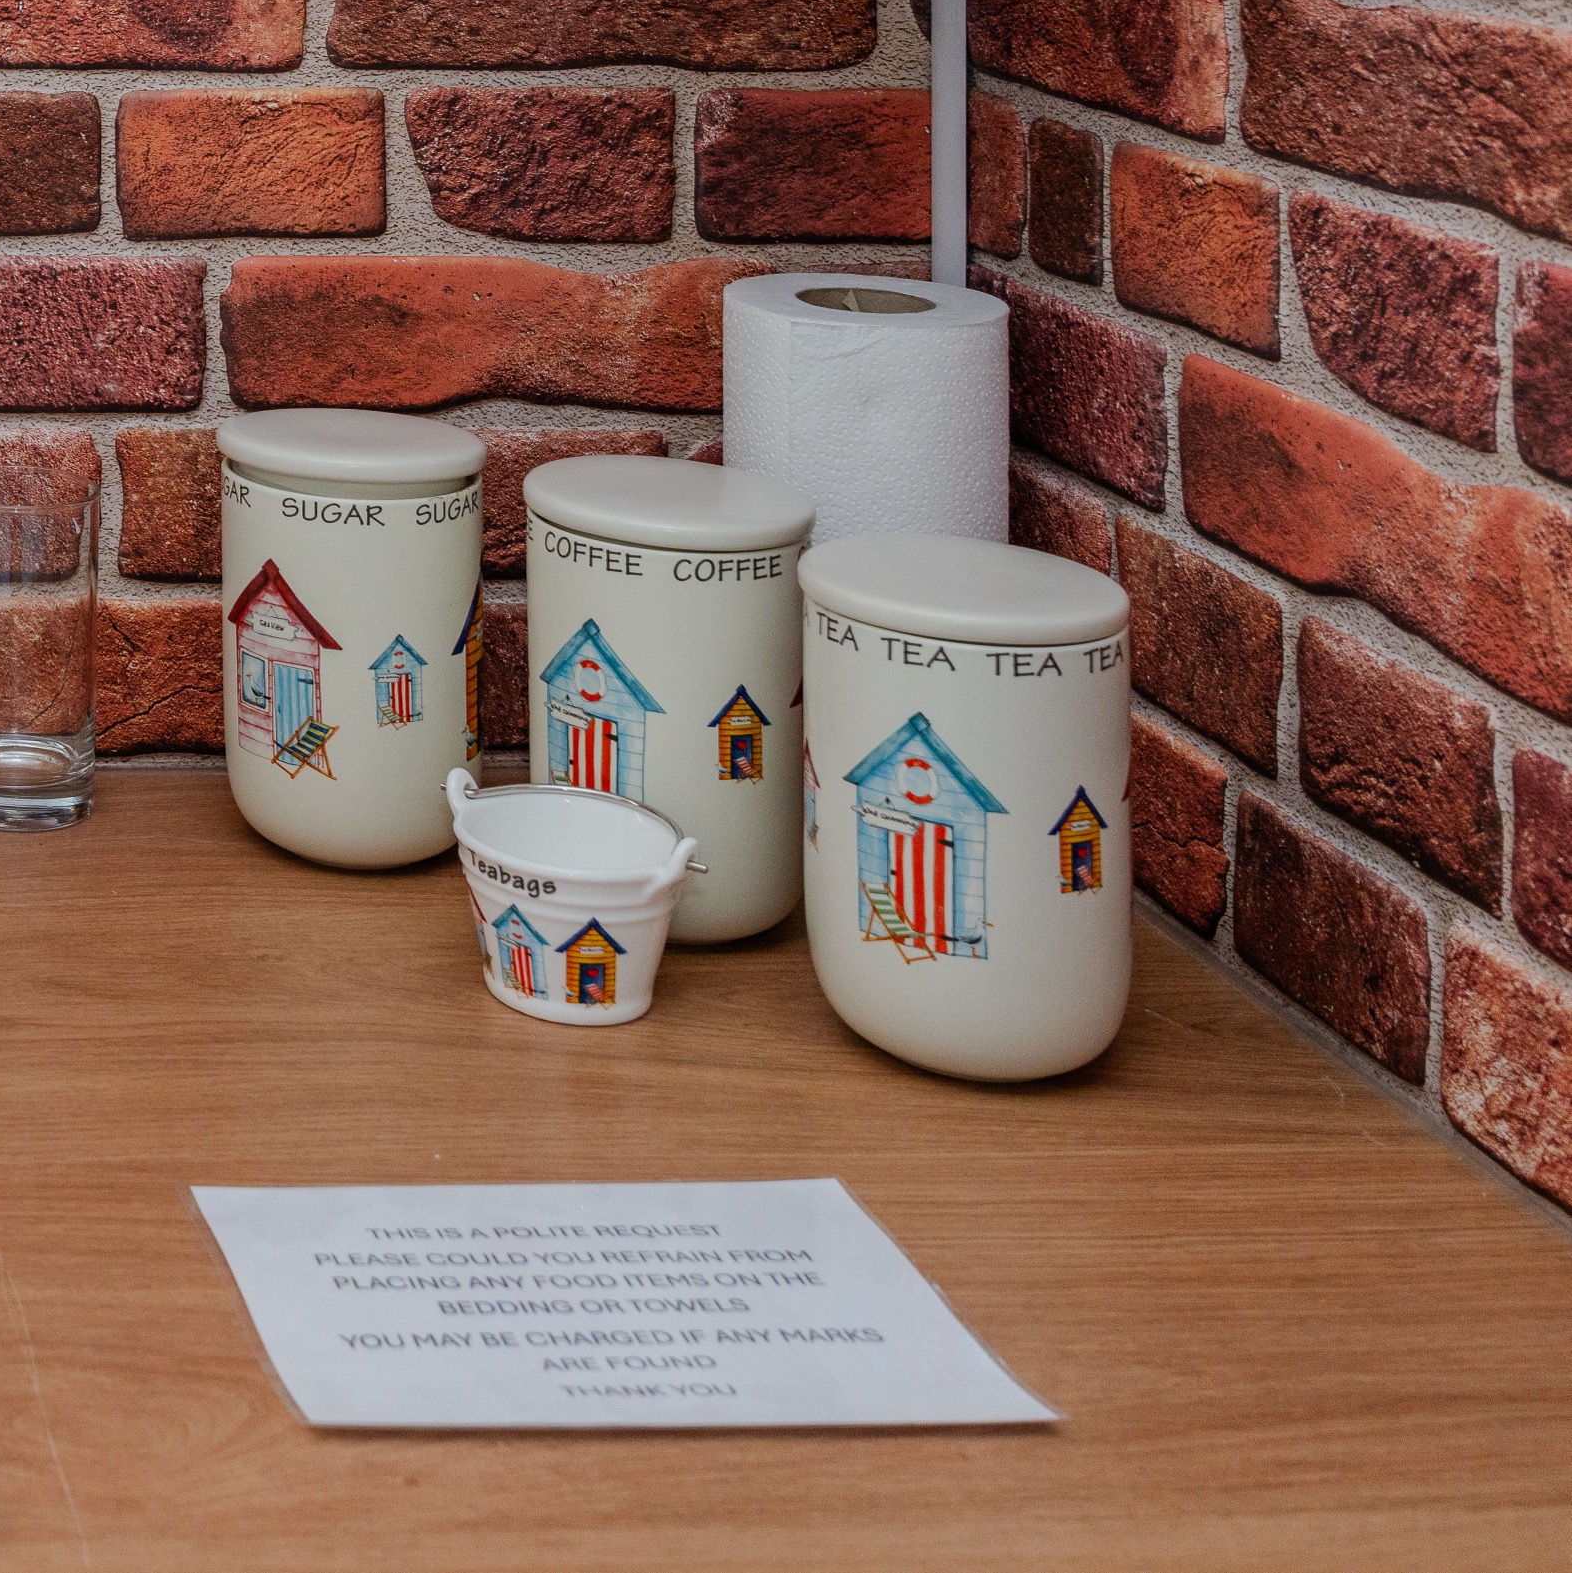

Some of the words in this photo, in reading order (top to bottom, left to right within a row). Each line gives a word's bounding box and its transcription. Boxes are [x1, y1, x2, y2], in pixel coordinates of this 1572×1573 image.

[281, 496, 386, 527] SUGAR
[416, 490, 480, 526] SUGAR
[544, 531, 644, 577] COFFEE
[673, 554, 783, 583] COFFEE
[816, 611, 859, 652] TEA
[880, 636, 956, 672] TEA
[986, 652, 1062, 678] TEA
[1083, 639, 1124, 675] TEA
[466, 847, 557, 898] Teabags
[367, 1227, 431, 1240] THIS
[435, 1227, 463, 1240] IS
[470, 1227, 489, 1239] A
[492, 1226, 590, 1239] POLITE
[593, 1224, 721, 1238] REQUEST
[314, 1253, 421, 1266] PLEASE
[426, 1252, 530, 1266] COULD
[532, 1251, 596, 1264] YOU
[601, 1249, 723, 1264] REFRAIN
[727, 1249, 813, 1262] FROM
[332, 1275, 461, 1290] PLACING
[469, 1275, 526, 1289] ANY
[531, 1274, 617, 1288] FOOD
[622, 1273, 709, 1287] ITEMS
[713, 1272, 763, 1287] ON
[763, 1271, 825, 1287] THE
[437, 1300, 574, 1314] BEDDING
[580, 1299, 625, 1314] OR
[627, 1297, 751, 1313] TOWELS
[339, 1333, 405, 1349] YOU
[411, 1332, 472, 1349] MAY
[479, 1331, 519, 1348] BE
[524, 1330, 674, 1347] CHARGED
[678, 1329, 706, 1344] IF
[716, 1328, 771, 1344] ANY
[777, 1327, 885, 1343] MARKS
[542, 1357, 601, 1372] ARE
[606, 1354, 717, 1370] FOUND
[560, 1384, 667, 1397] THANK
[668, 1383, 737, 1397] YOU
